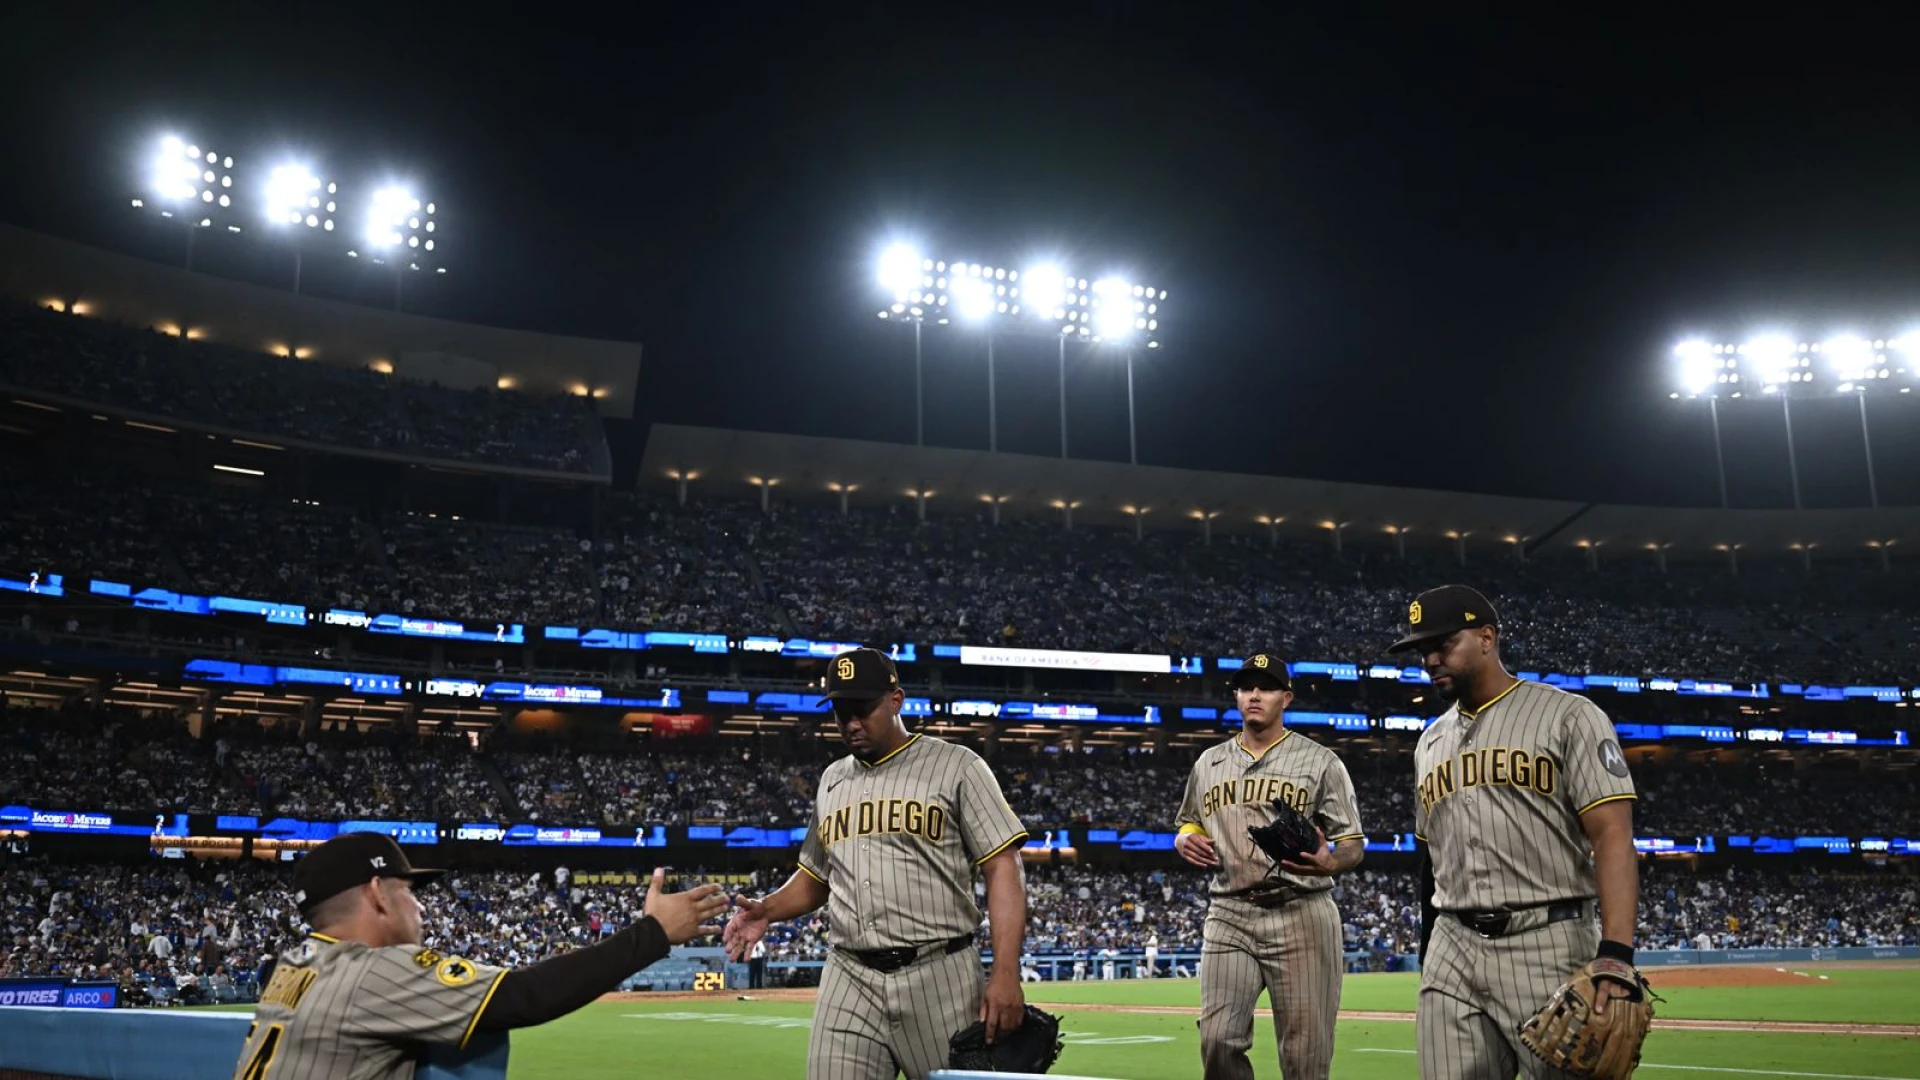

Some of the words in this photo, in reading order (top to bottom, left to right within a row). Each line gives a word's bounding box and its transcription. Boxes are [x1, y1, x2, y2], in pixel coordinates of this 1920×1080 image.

[981, 655, 1010, 663] BANK
[1014, 656, 1027, 664] OF
[1031, 657, 1079, 666] AMERICA
[1460, 747, 1556, 796] DIEGO
[1202, 778, 1237, 818] SAN
[1242, 777, 1309, 817] DIEGO
[818, 804, 852, 848] AN
[857, 797, 945, 843] DIEGO
[16, 990, 59, 1004] TIRES
[66, 992, 100, 1005] ARCO
